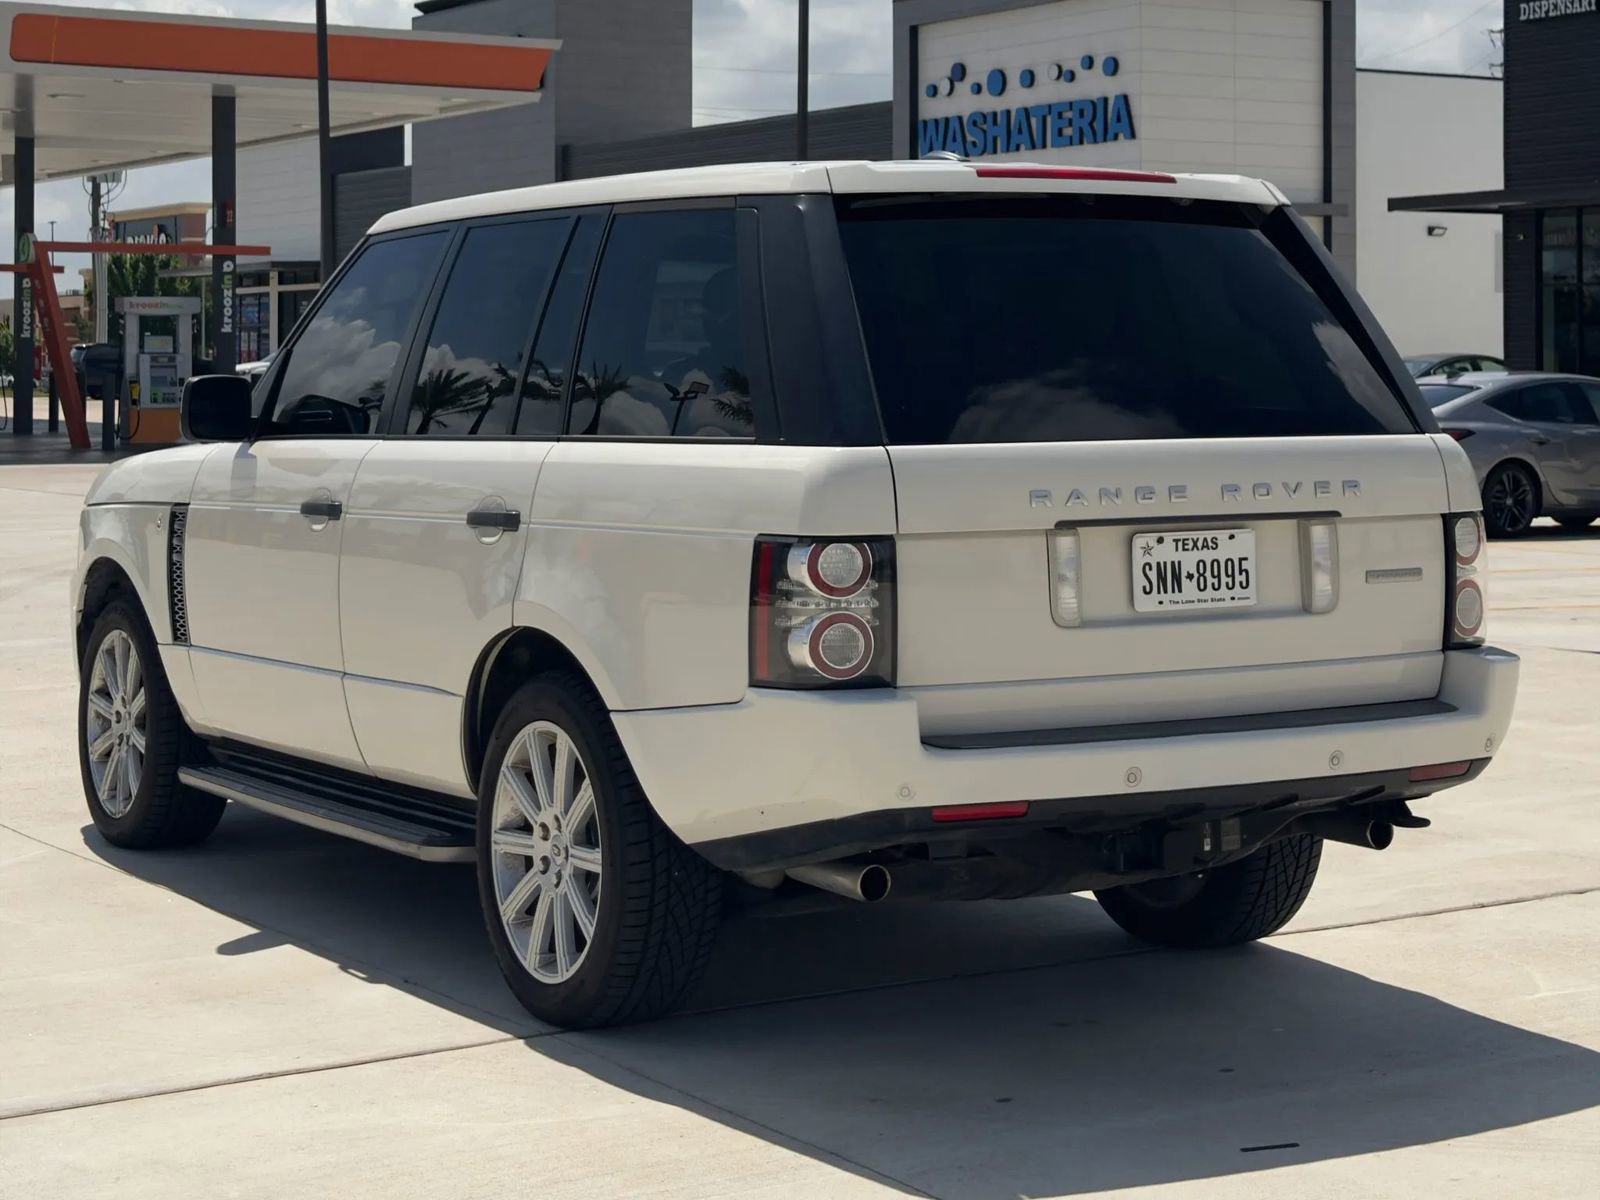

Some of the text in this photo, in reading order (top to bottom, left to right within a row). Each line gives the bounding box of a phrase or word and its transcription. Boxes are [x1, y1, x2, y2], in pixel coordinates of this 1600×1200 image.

[1519, 0, 1597, 20] DISPENSARY
[918, 93, 1136, 158] WASHATERIA
[1028, 480, 1362, 508] RANGE ROVER
[1172, 536, 1219, 552] TEXAS
[1142, 557, 1250, 595] SNN 8995
